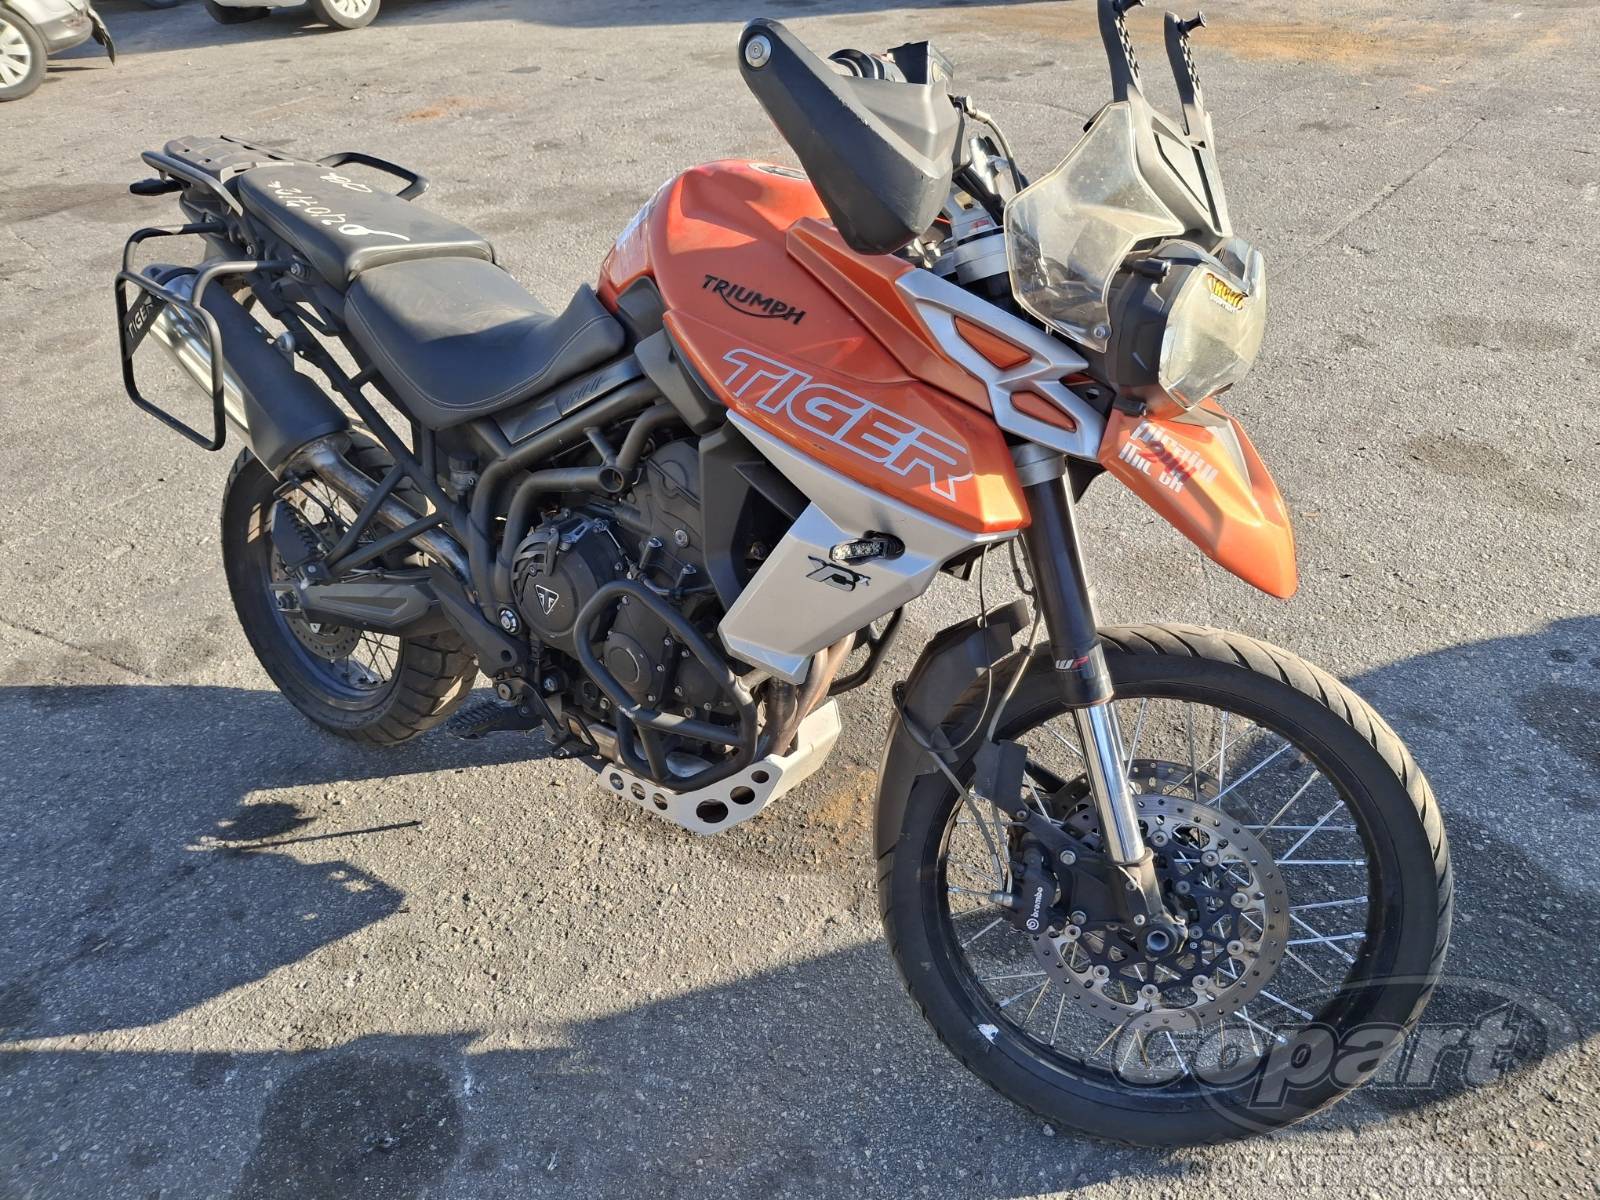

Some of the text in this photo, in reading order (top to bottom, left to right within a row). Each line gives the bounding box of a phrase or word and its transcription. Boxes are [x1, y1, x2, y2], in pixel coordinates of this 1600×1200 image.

[702, 274, 806, 325] TRIUMPH
[722, 348, 975, 502] TIGER
[1055, 655, 1089, 670] WP
[1030, 886, 1043, 918] brembo
